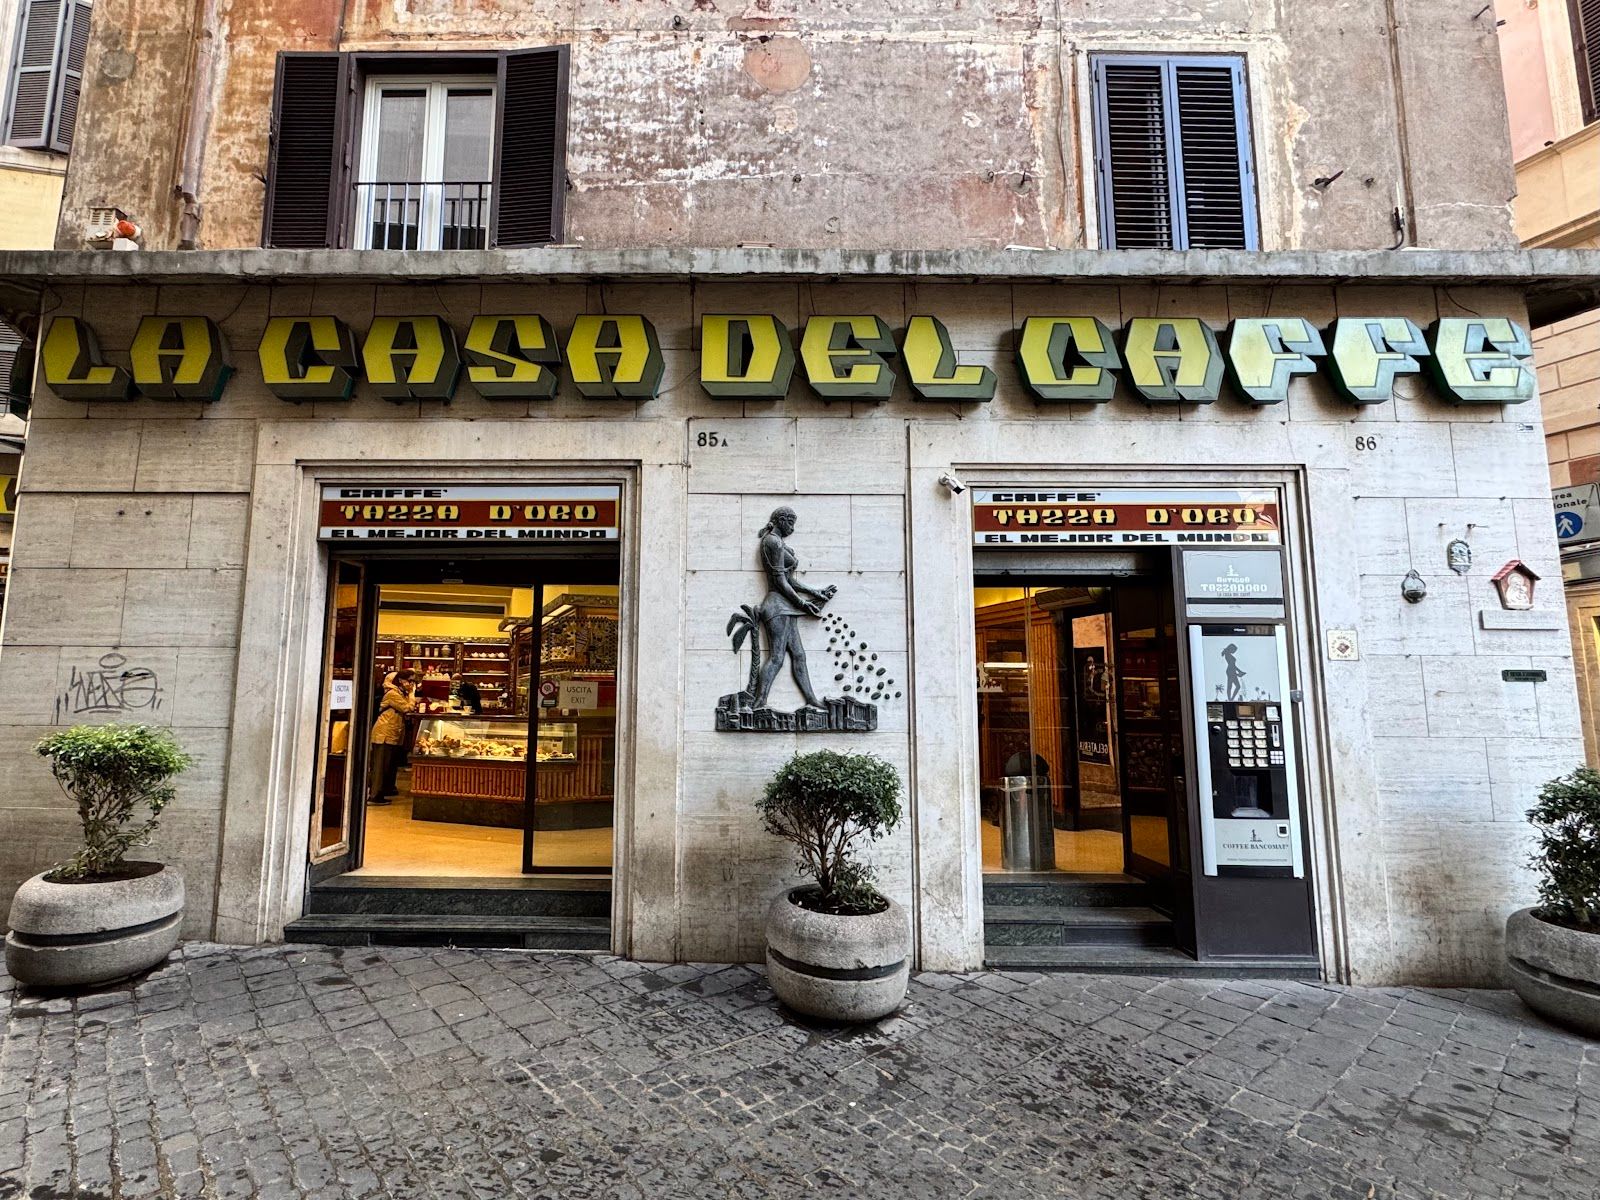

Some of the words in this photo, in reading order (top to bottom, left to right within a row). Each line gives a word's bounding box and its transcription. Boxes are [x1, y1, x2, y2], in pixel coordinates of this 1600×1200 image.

[41, 315, 213, 384] LA
[258, 314, 652, 384] CASA
[700, 314, 985, 385] DEL
[1019, 316, 1521, 388] CAFFE
[1355, 436, 1377, 451] 86
[1552, 492, 1572, 500] rea
[340, 504, 460, 522] TAZZA
[489, 504, 597, 522] D'ORO
[992, 508, 1116, 526] TAZZA
[1145, 507, 1257, 525] D'ORO
[331, 529, 360, 538] EL
[367, 529, 460, 539] MEJOR
[466, 529, 513, 539] DEL
[517, 529, 607, 539] MUNDO
[984, 534, 1014, 543] EL
[1020, 534, 1114, 543] MEJOR
[1122, 533, 1170, 543] DEL
[1177, 533, 1270, 543] MUNDO
[566, 686, 593, 694] USCITA
[570, 696, 586, 704] EXIT
